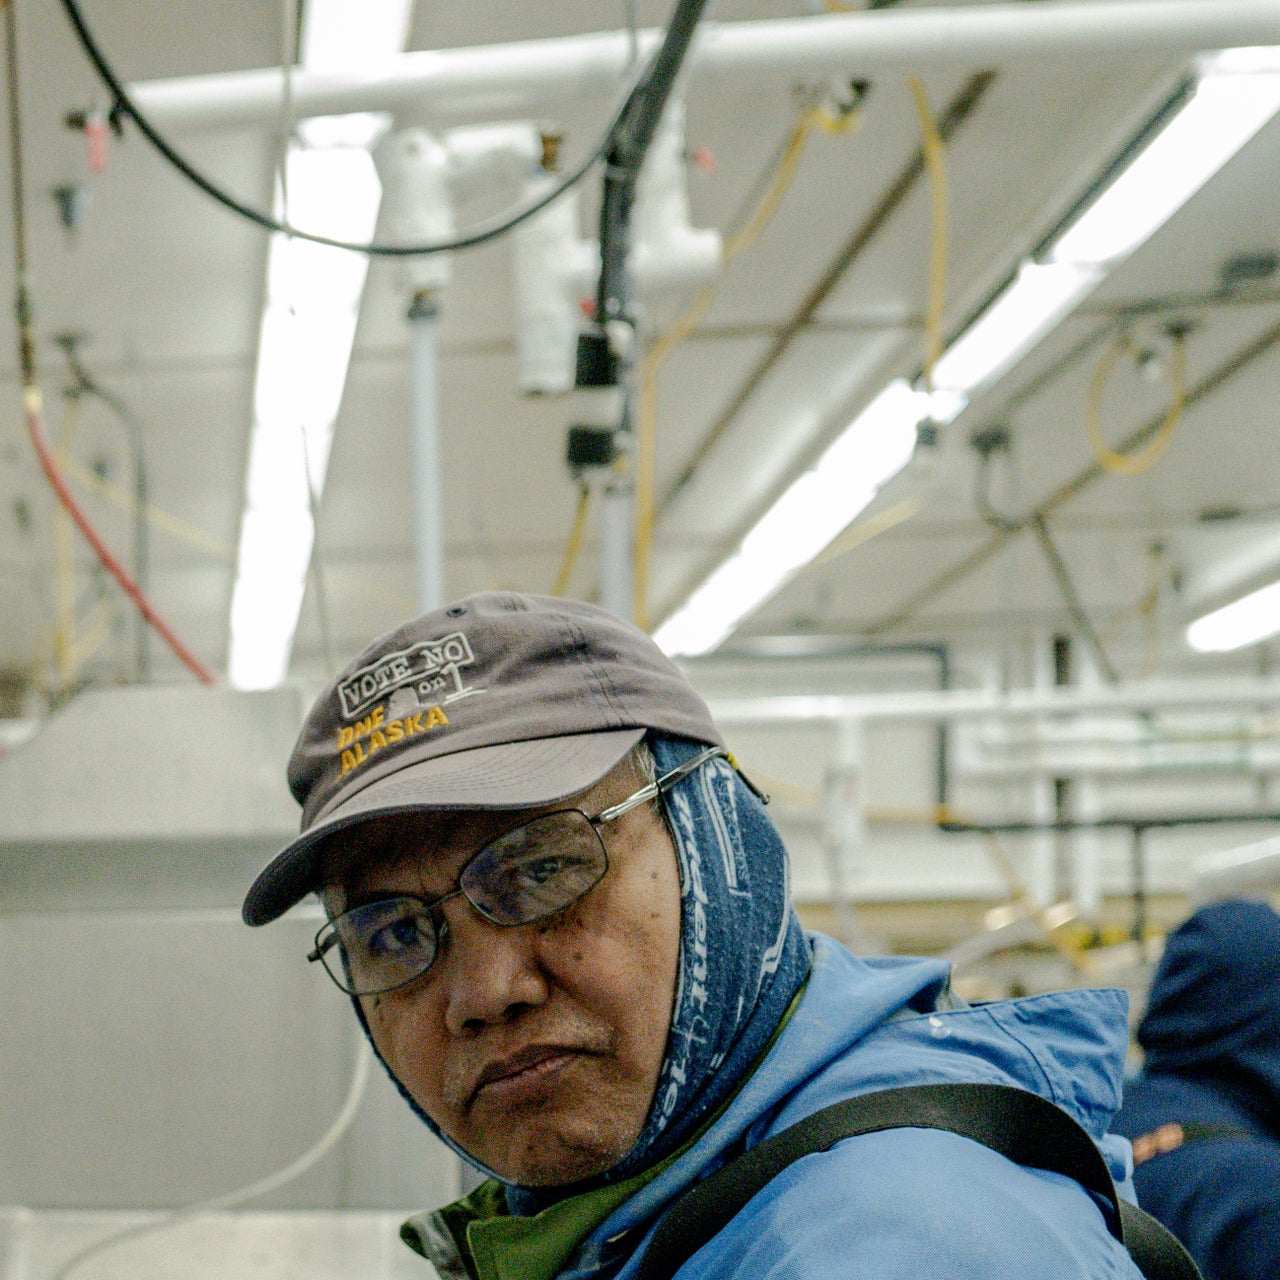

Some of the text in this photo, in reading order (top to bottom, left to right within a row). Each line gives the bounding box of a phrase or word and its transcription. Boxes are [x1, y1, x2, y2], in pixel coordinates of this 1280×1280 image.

[344, 641, 464, 706] VOTE NO
[418, 662, 473, 699] on 1
[334, 706, 449, 782] ALASKA
[336, 706, 384, 750] ONE
